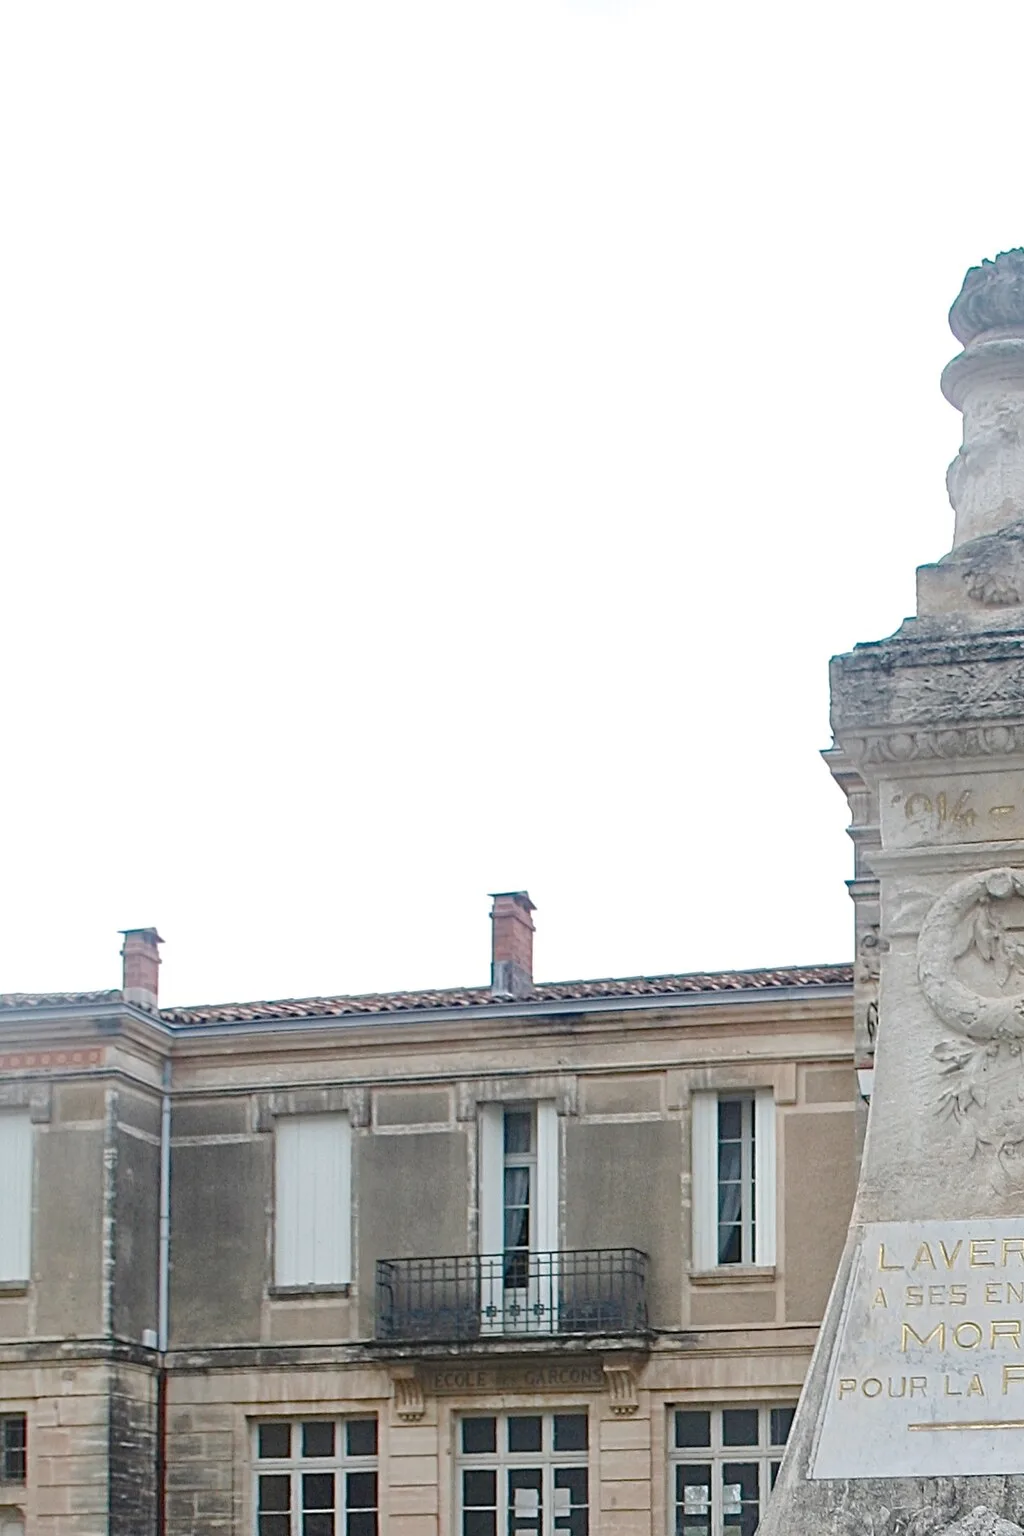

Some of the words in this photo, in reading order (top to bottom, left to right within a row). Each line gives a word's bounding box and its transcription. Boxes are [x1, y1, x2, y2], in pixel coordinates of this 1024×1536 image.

[891, 788, 978, 830] 914
[872, 1287, 889, 1309] A
[905, 1284, 968, 1308] SES
[434, 1371, 487, 1388] ECOLE
[838, 1375, 928, 1401] POUR
[944, 1373, 985, 1397] LA
